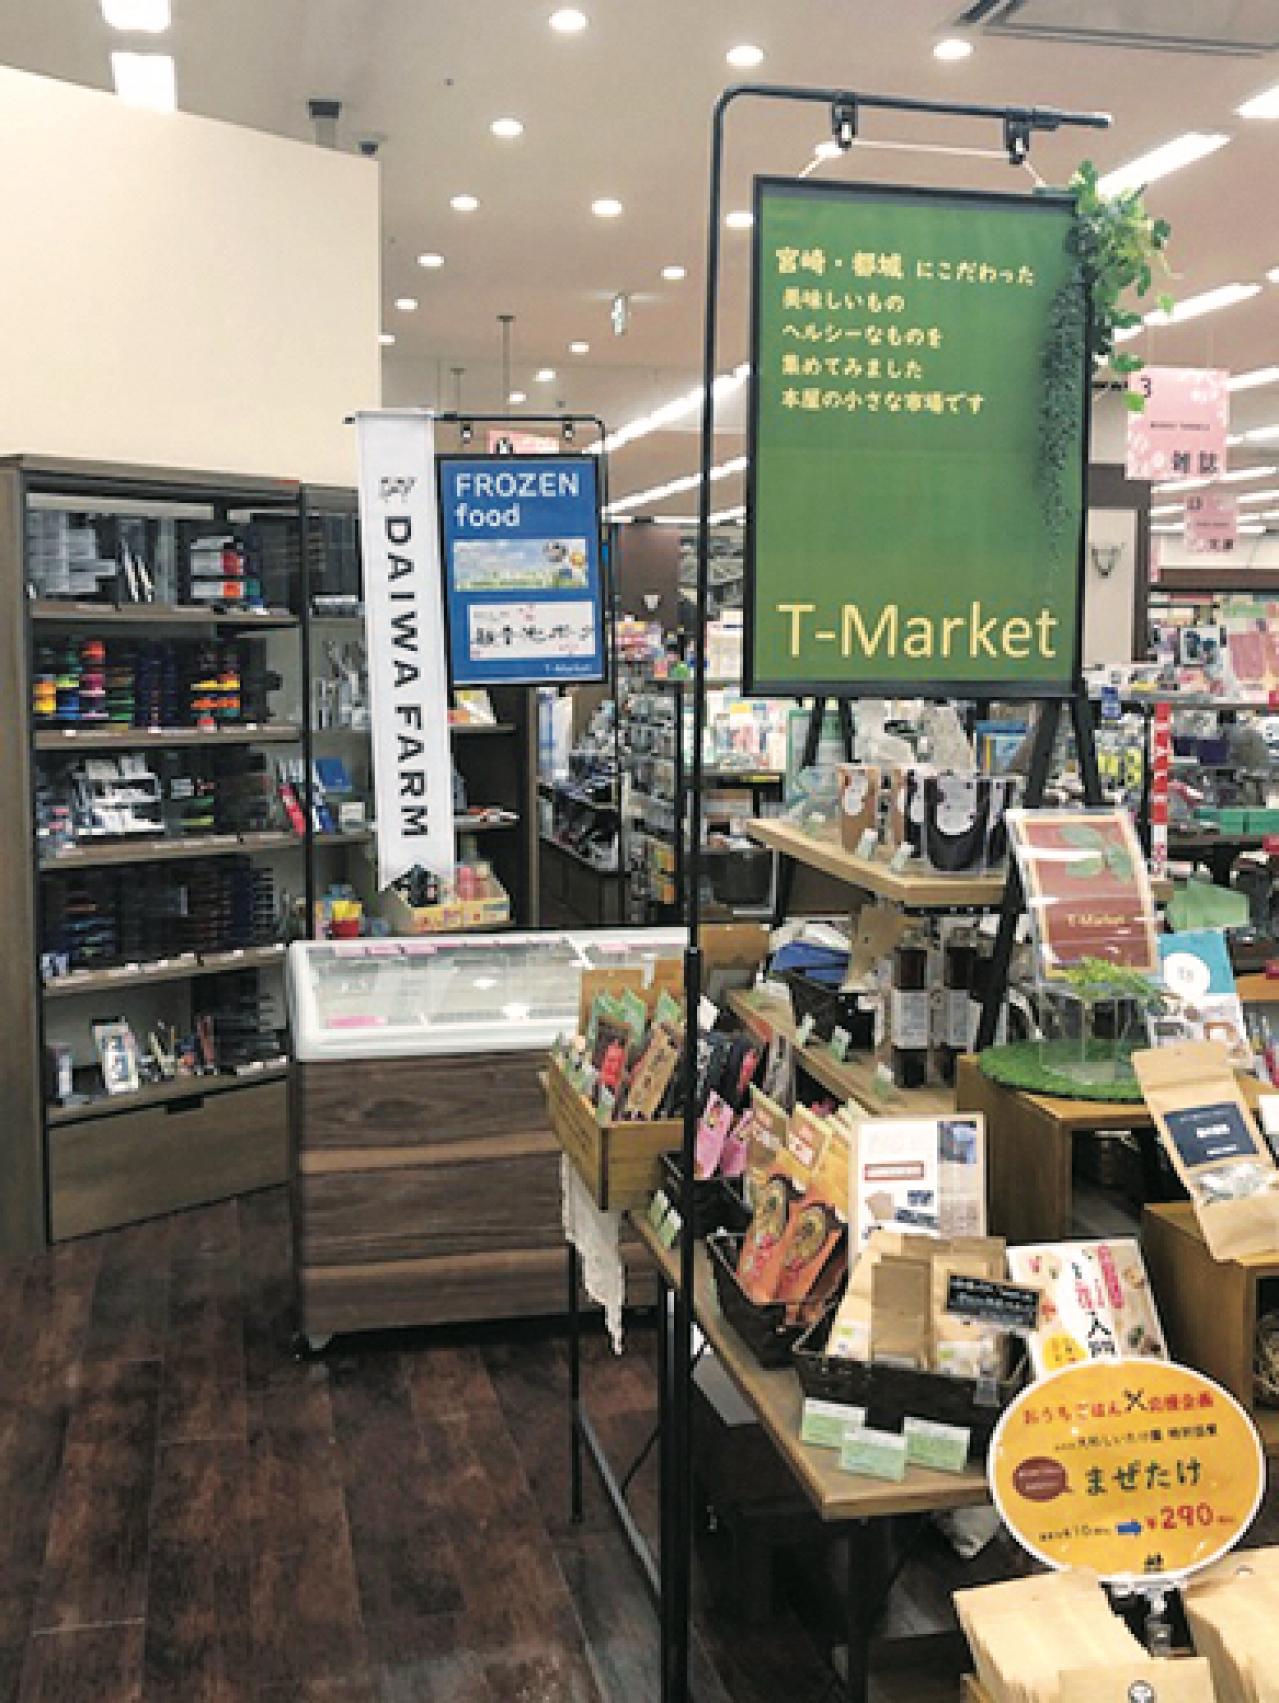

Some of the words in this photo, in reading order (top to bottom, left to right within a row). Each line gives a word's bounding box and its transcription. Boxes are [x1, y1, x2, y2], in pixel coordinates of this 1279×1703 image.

[915, 258, 1036, 287] にこだわった
[781, 286, 905, 313] 美味しいもの
[781, 322, 944, 349] ヘルシーなものを
[781, 352, 923, 380] 集めてみました
[781, 387, 985, 416] 本屋の小さな市場です
[455, 472, 580, 498] FROZEN
[454, 502, 521, 527] food
[383, 514, 422, 688] DAIWA
[776, 601, 1059, 659] T-Market
[394, 705, 429, 837] FARM
[1085, 1456, 1201, 1496] まぜたけ
